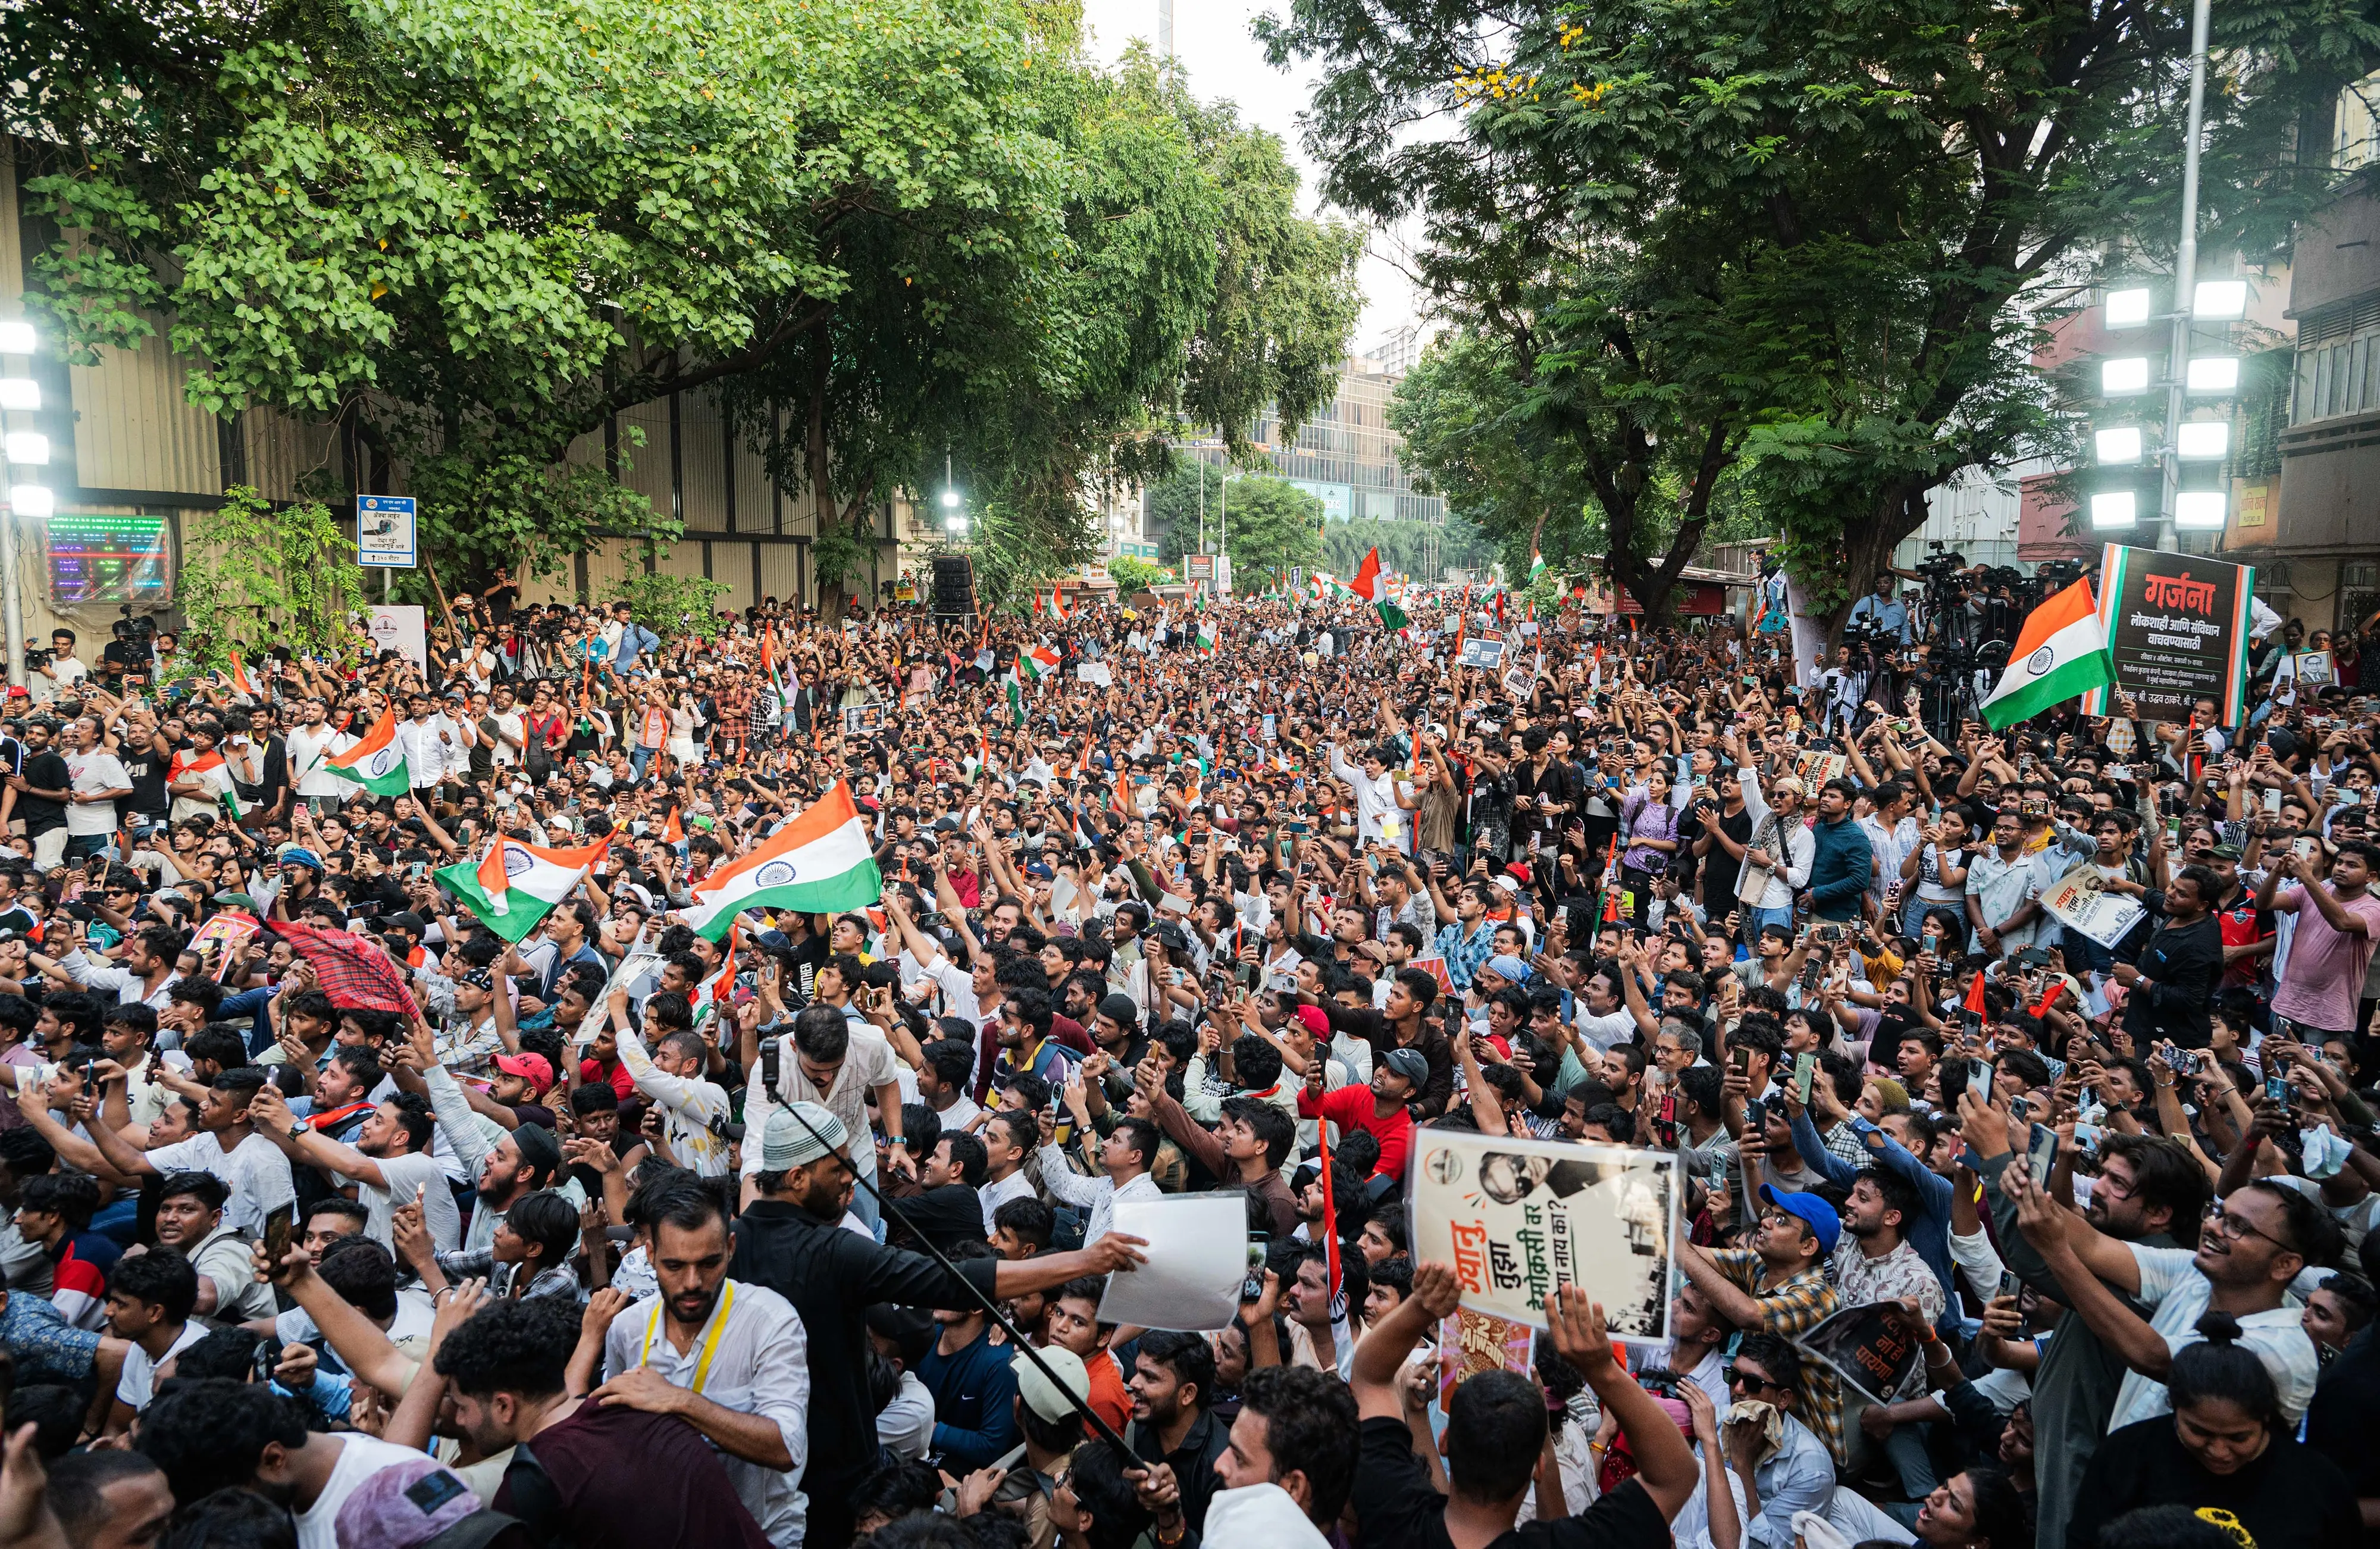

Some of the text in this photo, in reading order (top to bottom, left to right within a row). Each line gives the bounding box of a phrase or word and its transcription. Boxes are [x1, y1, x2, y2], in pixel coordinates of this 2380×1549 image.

[2144, 571, 2216, 617] गर्जना
[2130, 611, 2221, 637] लोकशाही आणि संविधान
[2147, 633, 2201, 650] वाचवण्यासाठी
[2174, 656, 2187, 664] सकाळी
[1509, 672, 1533, 691] 2 OCTOBER
[2150, 677, 2159, 686] मुंबई
[2159, 677, 2178, 686] महापालिका
[2148, 693, 2163, 703] उद्धव
[2164, 693, 2182, 706] ठाकरे,
[2183, 695, 2191, 706] श्री.
[1806, 756, 1820, 779] CHURAYA
[1826, 756, 1833, 766] NE
[2066, 895, 2080, 912] तुझा
[2090, 892, 2097, 903] वर
[2081, 912, 2093, 927] भरोसा
[2091, 905, 2100, 916] नाय
[799, 962, 813, 997] PANTHER
[1524, 1203, 1541, 1225] वर
[1451, 1219, 1487, 1295] ग्यानु,
[1489, 1240, 1521, 1289] तुझा
[1552, 1238, 1569, 1271] नाय
[1477, 1317, 1490, 1338] 2
[1460, 1328, 1505, 1370] Ajwain
[1875, 1334, 1896, 1354] ना
[1856, 1344, 1894, 1382] पायेगा!
